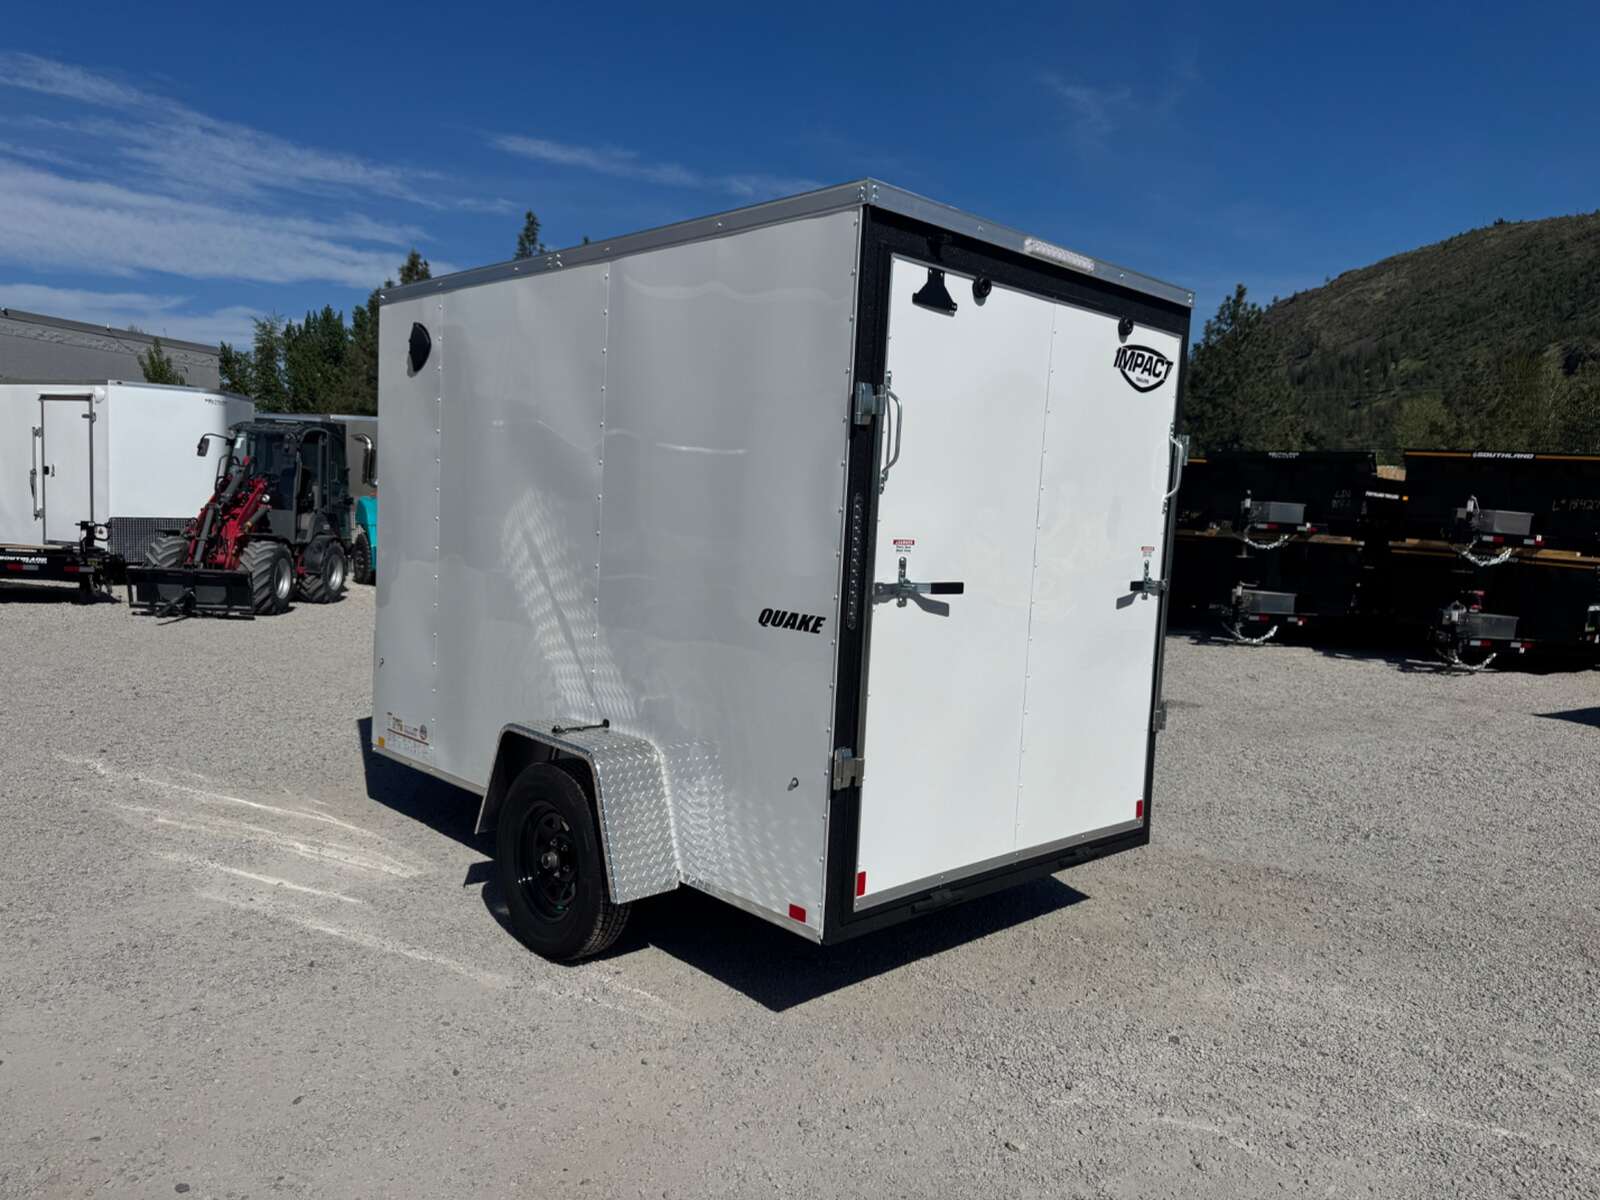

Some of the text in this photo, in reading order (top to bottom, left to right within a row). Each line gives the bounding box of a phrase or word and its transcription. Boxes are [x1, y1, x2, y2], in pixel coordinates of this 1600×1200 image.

[1113, 346, 1174, 380] IMPACT
[1477, 452, 1534, 460] SOUTHLAND
[758, 608, 826, 634] QUAKE
